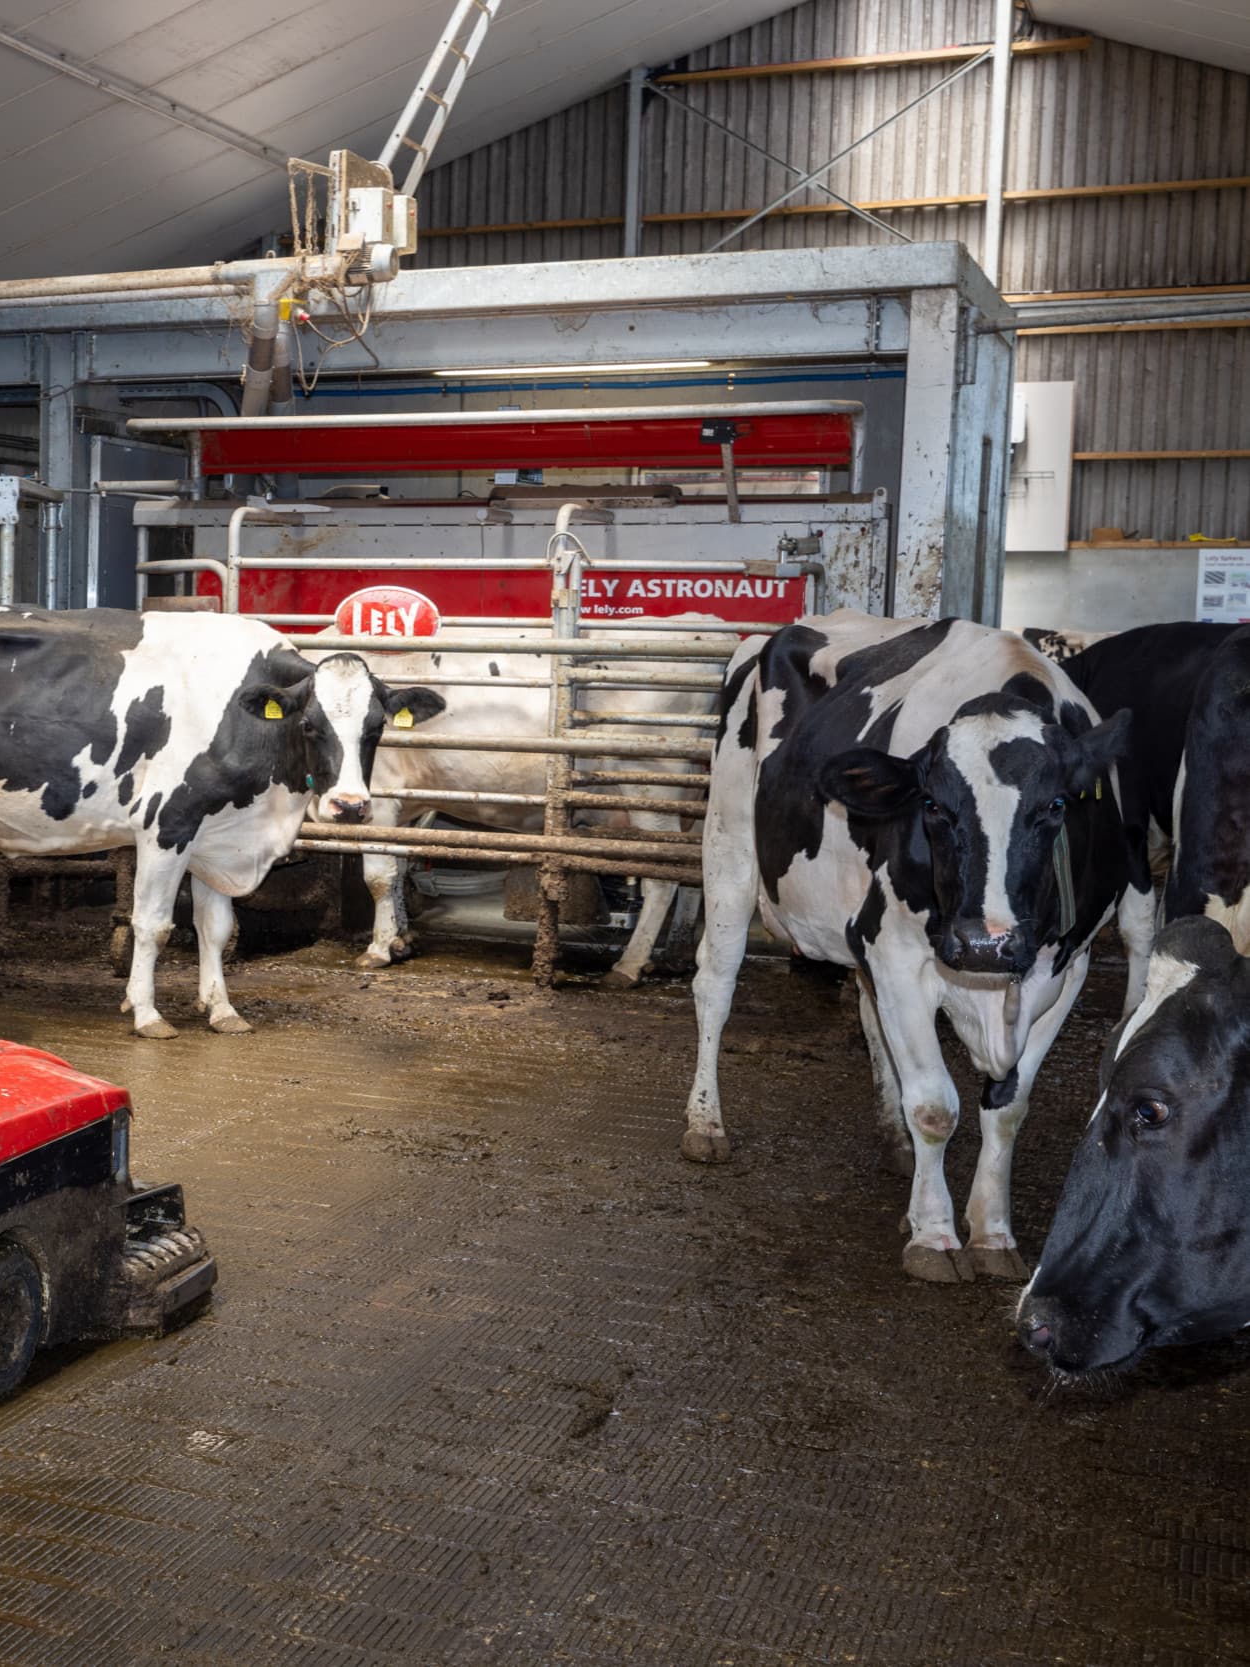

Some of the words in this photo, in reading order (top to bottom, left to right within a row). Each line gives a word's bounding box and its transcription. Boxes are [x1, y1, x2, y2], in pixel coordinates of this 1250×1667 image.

[581, 579, 619, 597] ELY
[625, 578, 790, 598] ASTRONAUT
[351, 600, 420, 637] LELY
